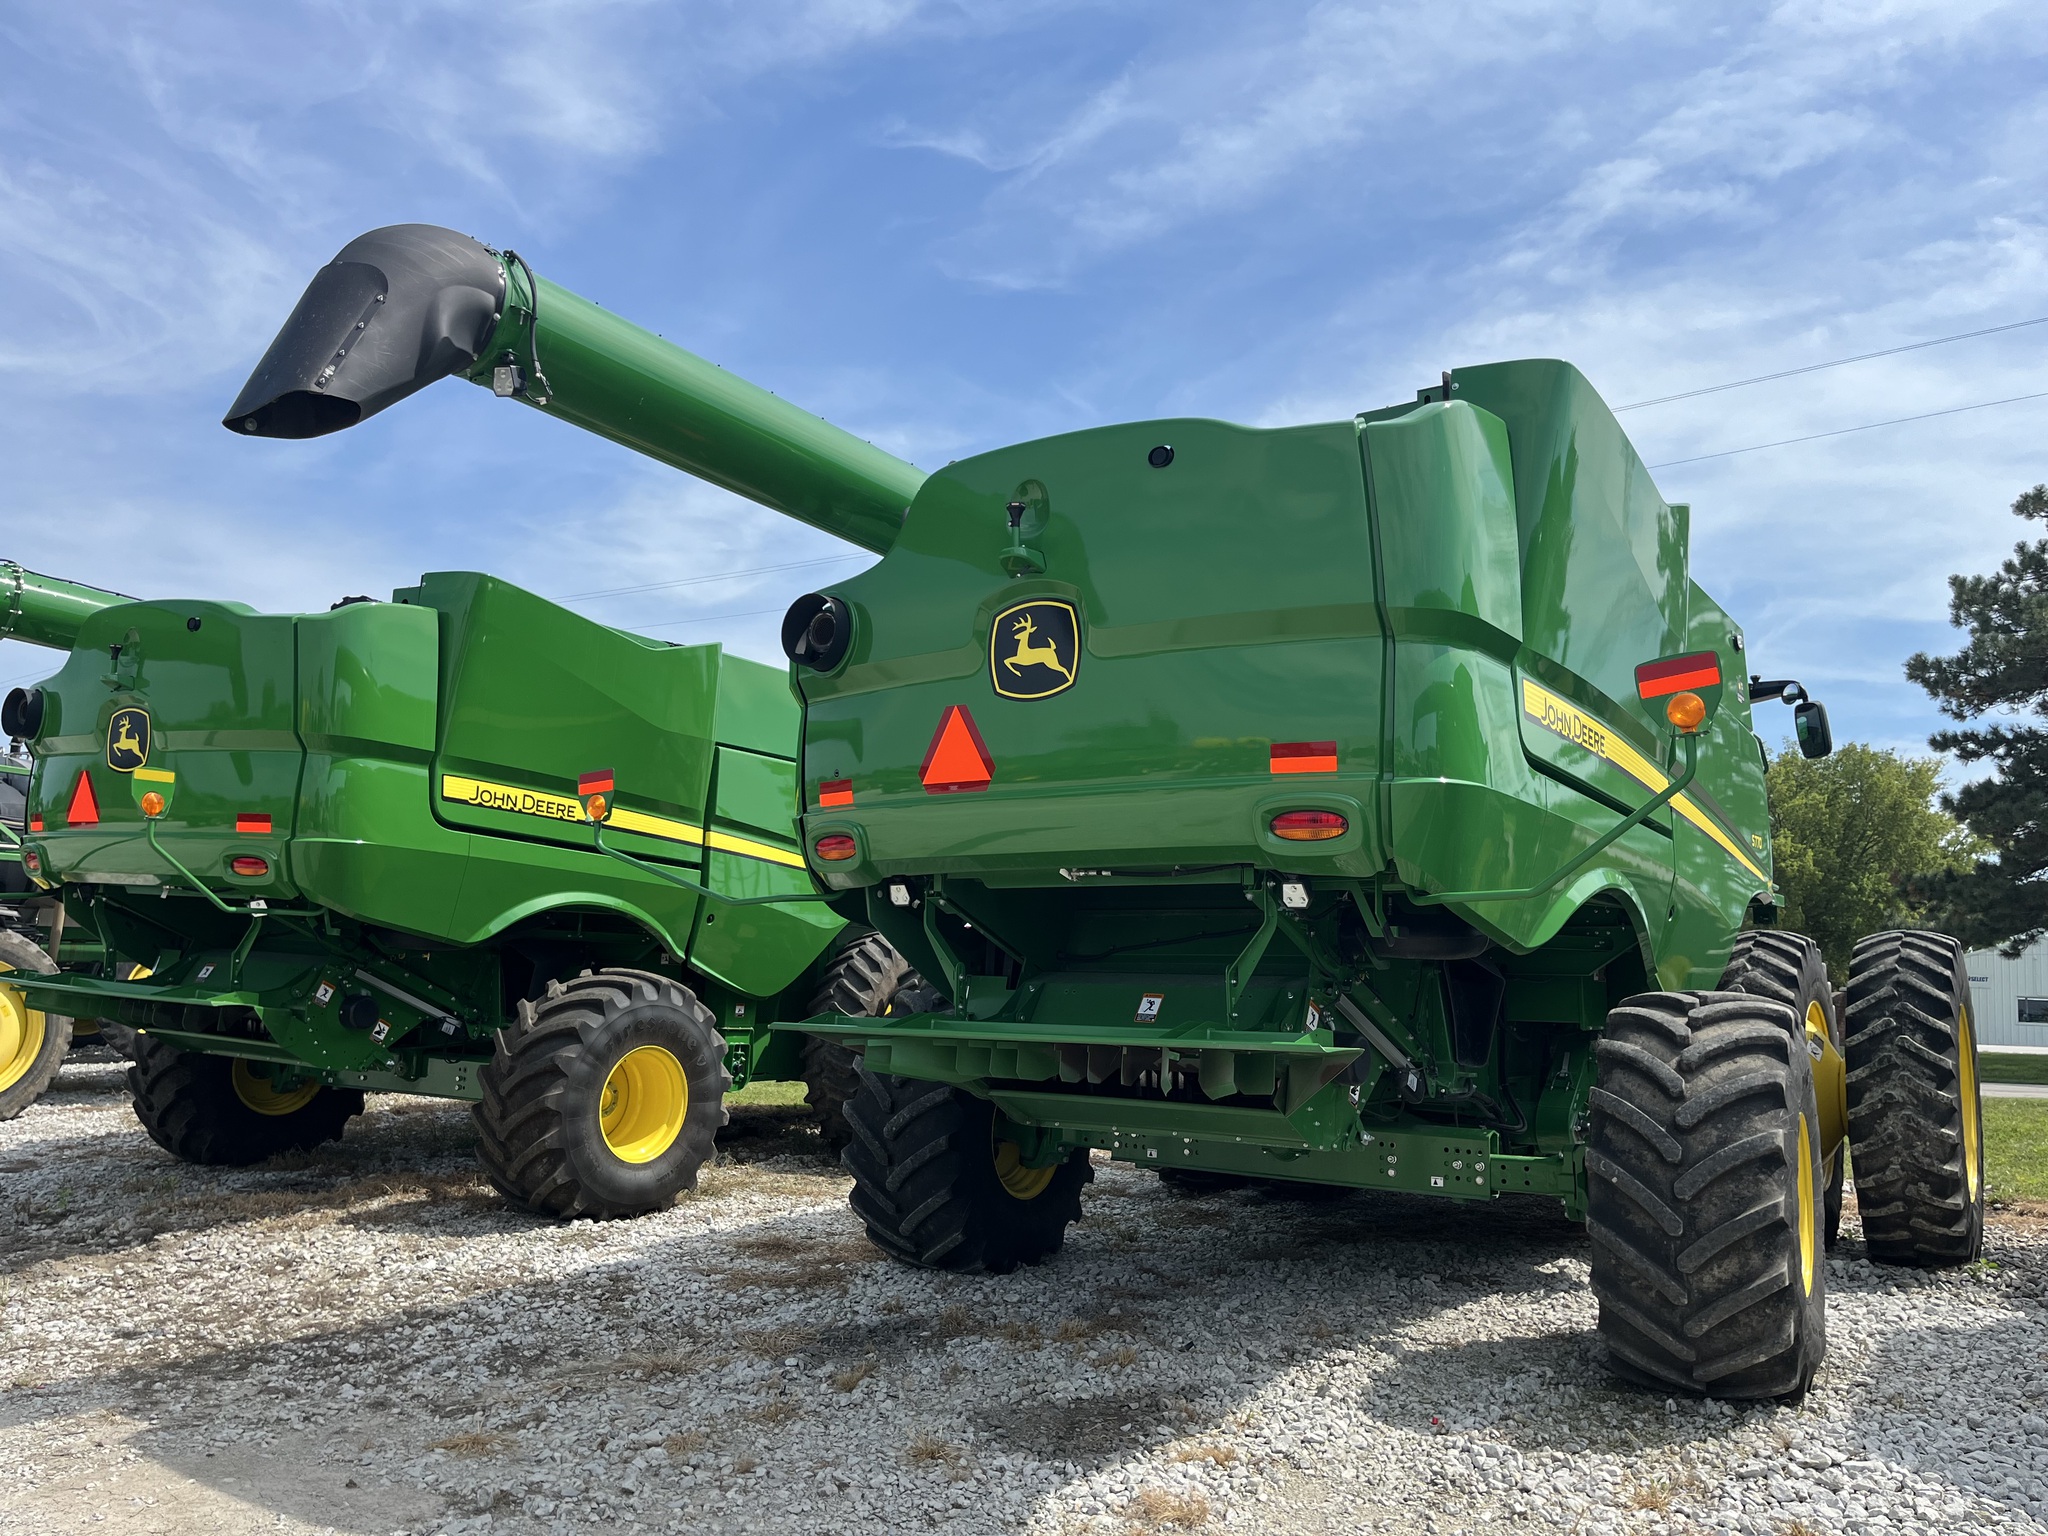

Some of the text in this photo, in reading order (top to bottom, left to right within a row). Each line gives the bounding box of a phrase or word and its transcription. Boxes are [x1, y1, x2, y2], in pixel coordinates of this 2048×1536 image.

[1541, 697, 1606, 755] JOHN DEERE
[469, 785, 577, 818] JOHN DEERE
